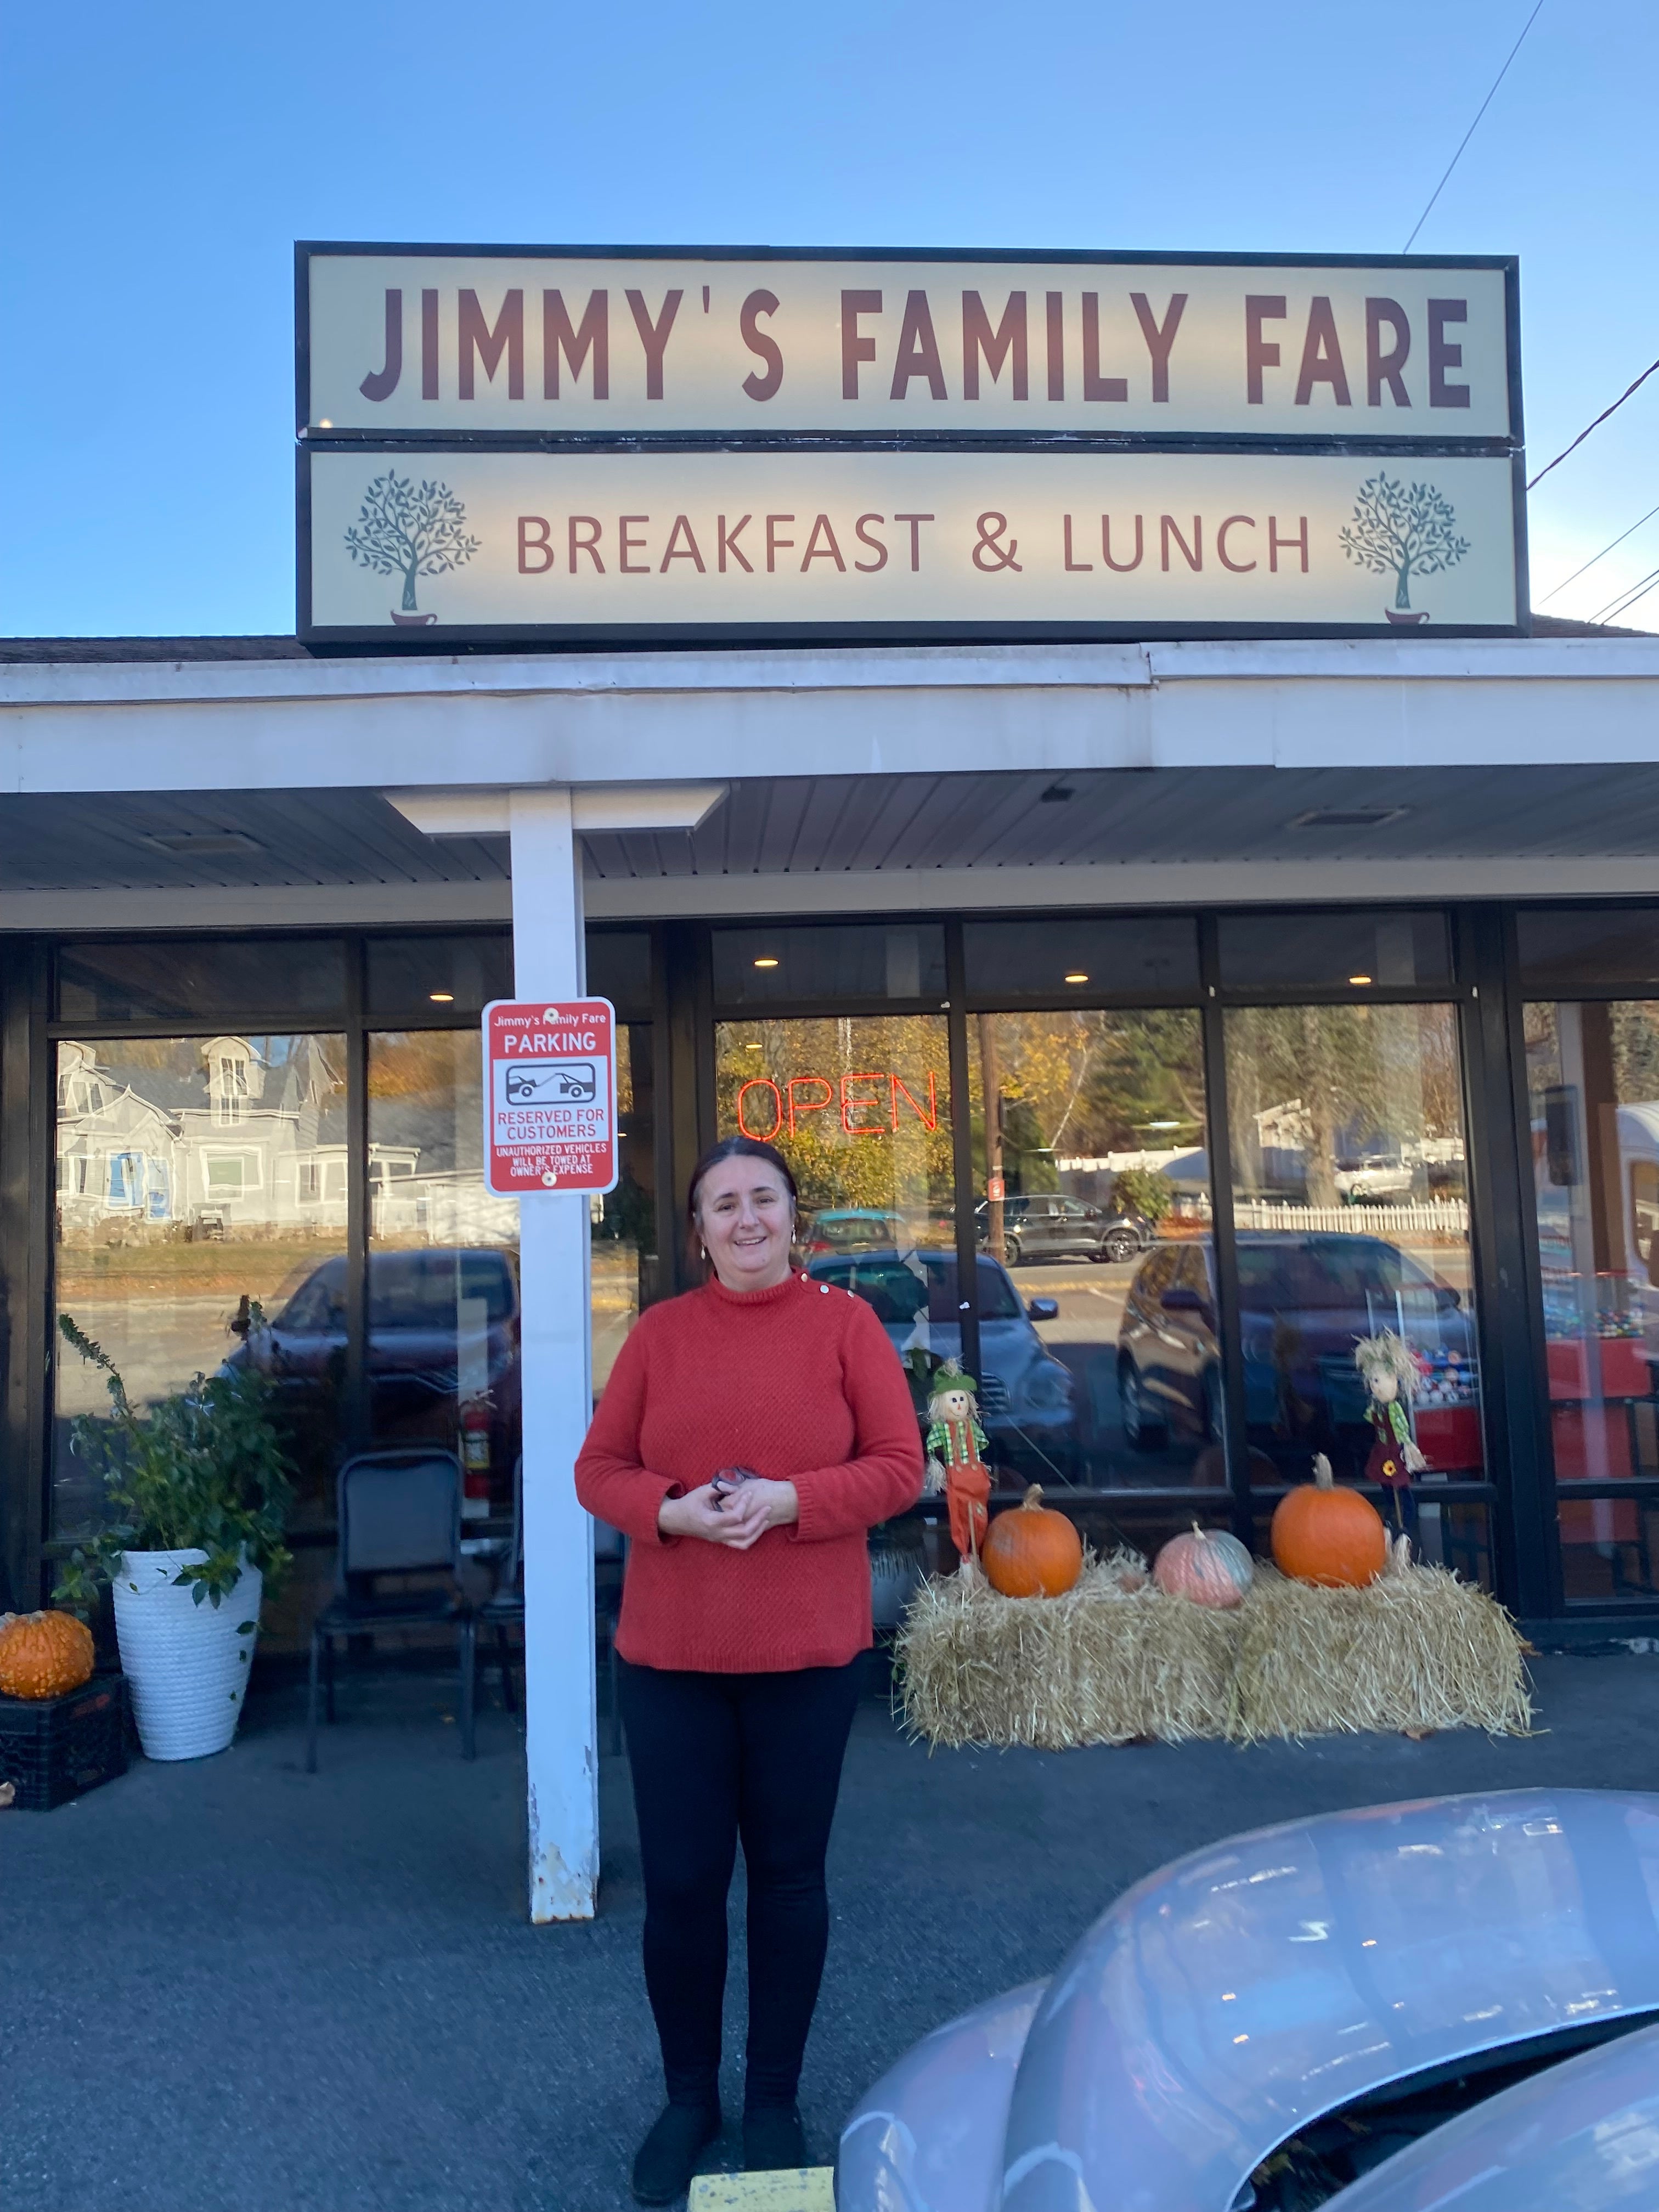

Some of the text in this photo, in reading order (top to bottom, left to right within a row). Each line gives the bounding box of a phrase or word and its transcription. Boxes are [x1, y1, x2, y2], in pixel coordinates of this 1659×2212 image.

[359, 286, 1471, 408] JIMMY'S FAMILY FARE
[517, 511, 1309, 574] BREAKFAST & LUNCH
[494, 1016, 539, 1029] Jimmy's
[582, 1013, 606, 1023] Fare
[504, 1032, 596, 1053] PARKING
[737, 1071, 936, 1142] OPEN
[498, 1109, 604, 1125] RESERVED FOR
[507, 1124, 596, 1140] CUSTOMERS
[496, 1143, 607, 1157] UNAUTHORIZED VEHICLES
[512, 1154, 591, 1167] WILL BE TOWED AT
[510, 1164, 593, 1177] OWNER'S EXPENSE
